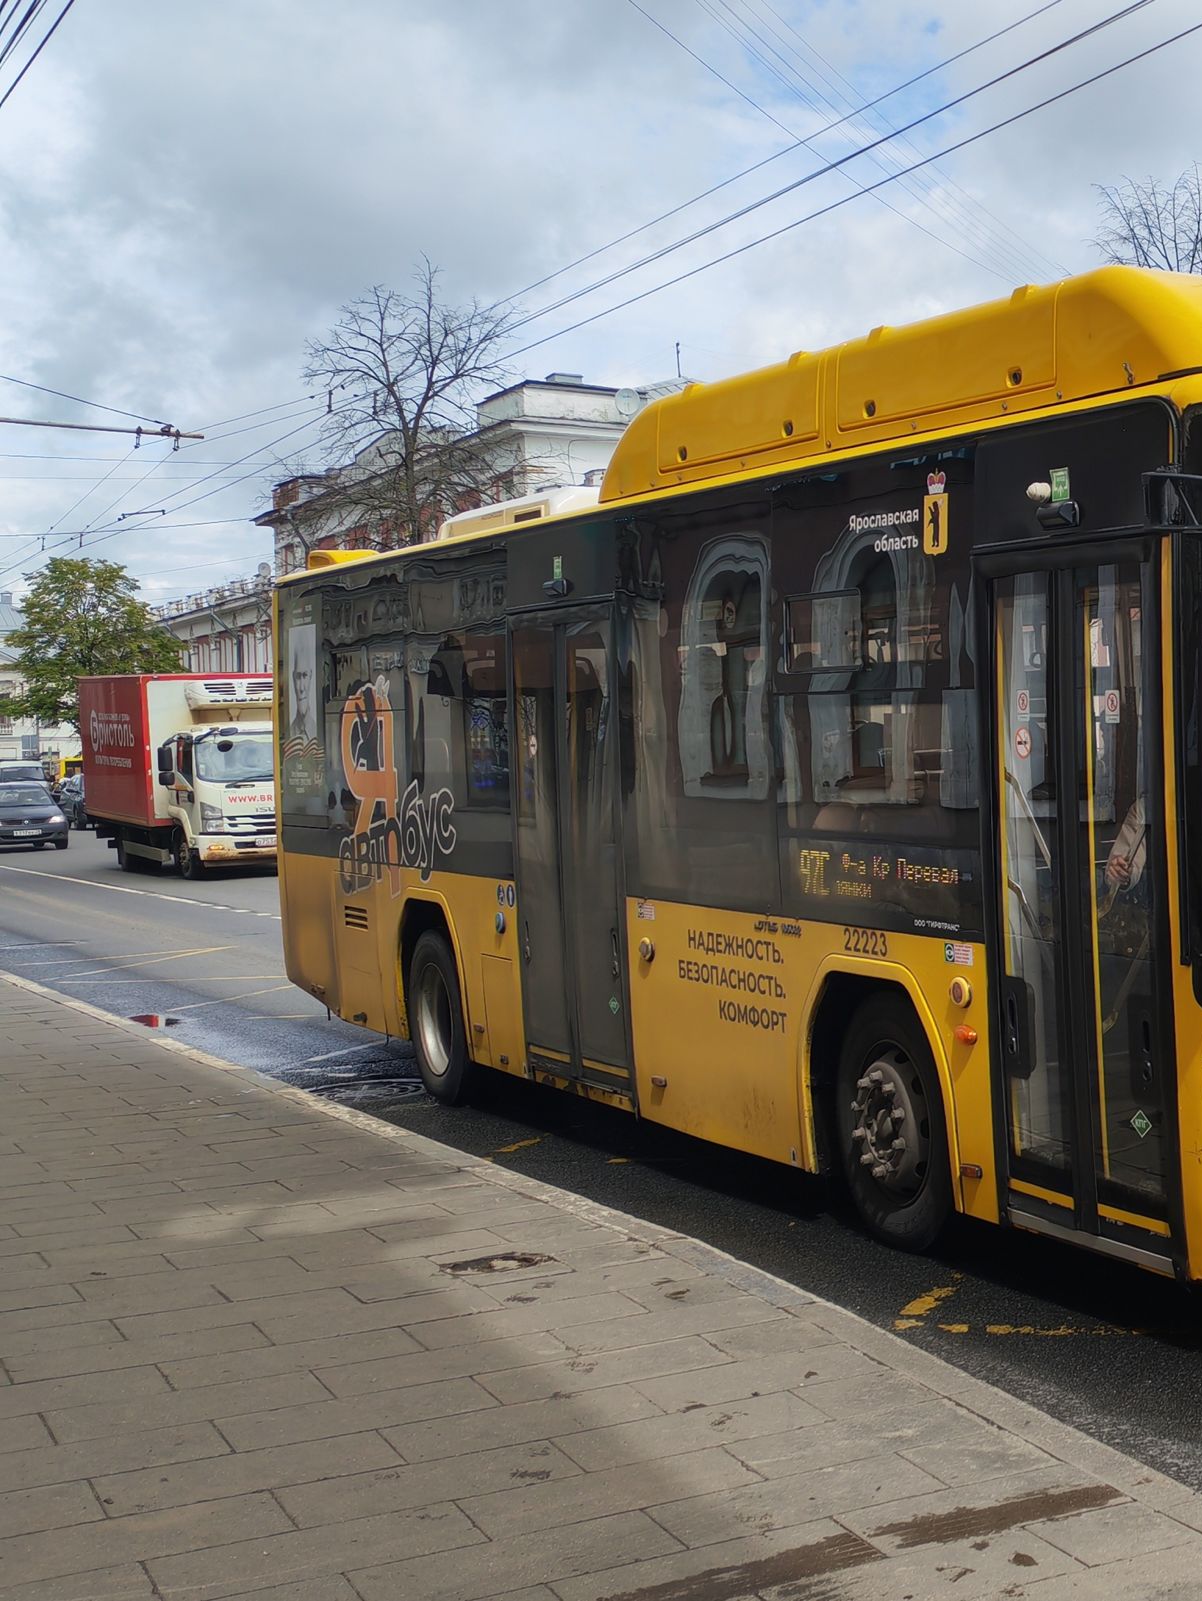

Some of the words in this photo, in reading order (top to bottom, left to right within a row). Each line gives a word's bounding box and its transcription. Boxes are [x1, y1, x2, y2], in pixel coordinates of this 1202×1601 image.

[849, 508, 919, 534] Ярославская
[874, 535, 919, 553] область
[339, 779, 457, 897] автобус
[873, 856, 890, 880] Кр
[897, 858, 959, 884] Перевал
[913, 919, 926, 927] ООО
[688, 929, 784, 964] НАДЕЖНОСТЬ.
[844, 928, 887, 957] 22223
[678, 960, 786, 999] БЕЗОПАСНОСТЬ.
[719, 999, 787, 1033] КОМФОРТ
